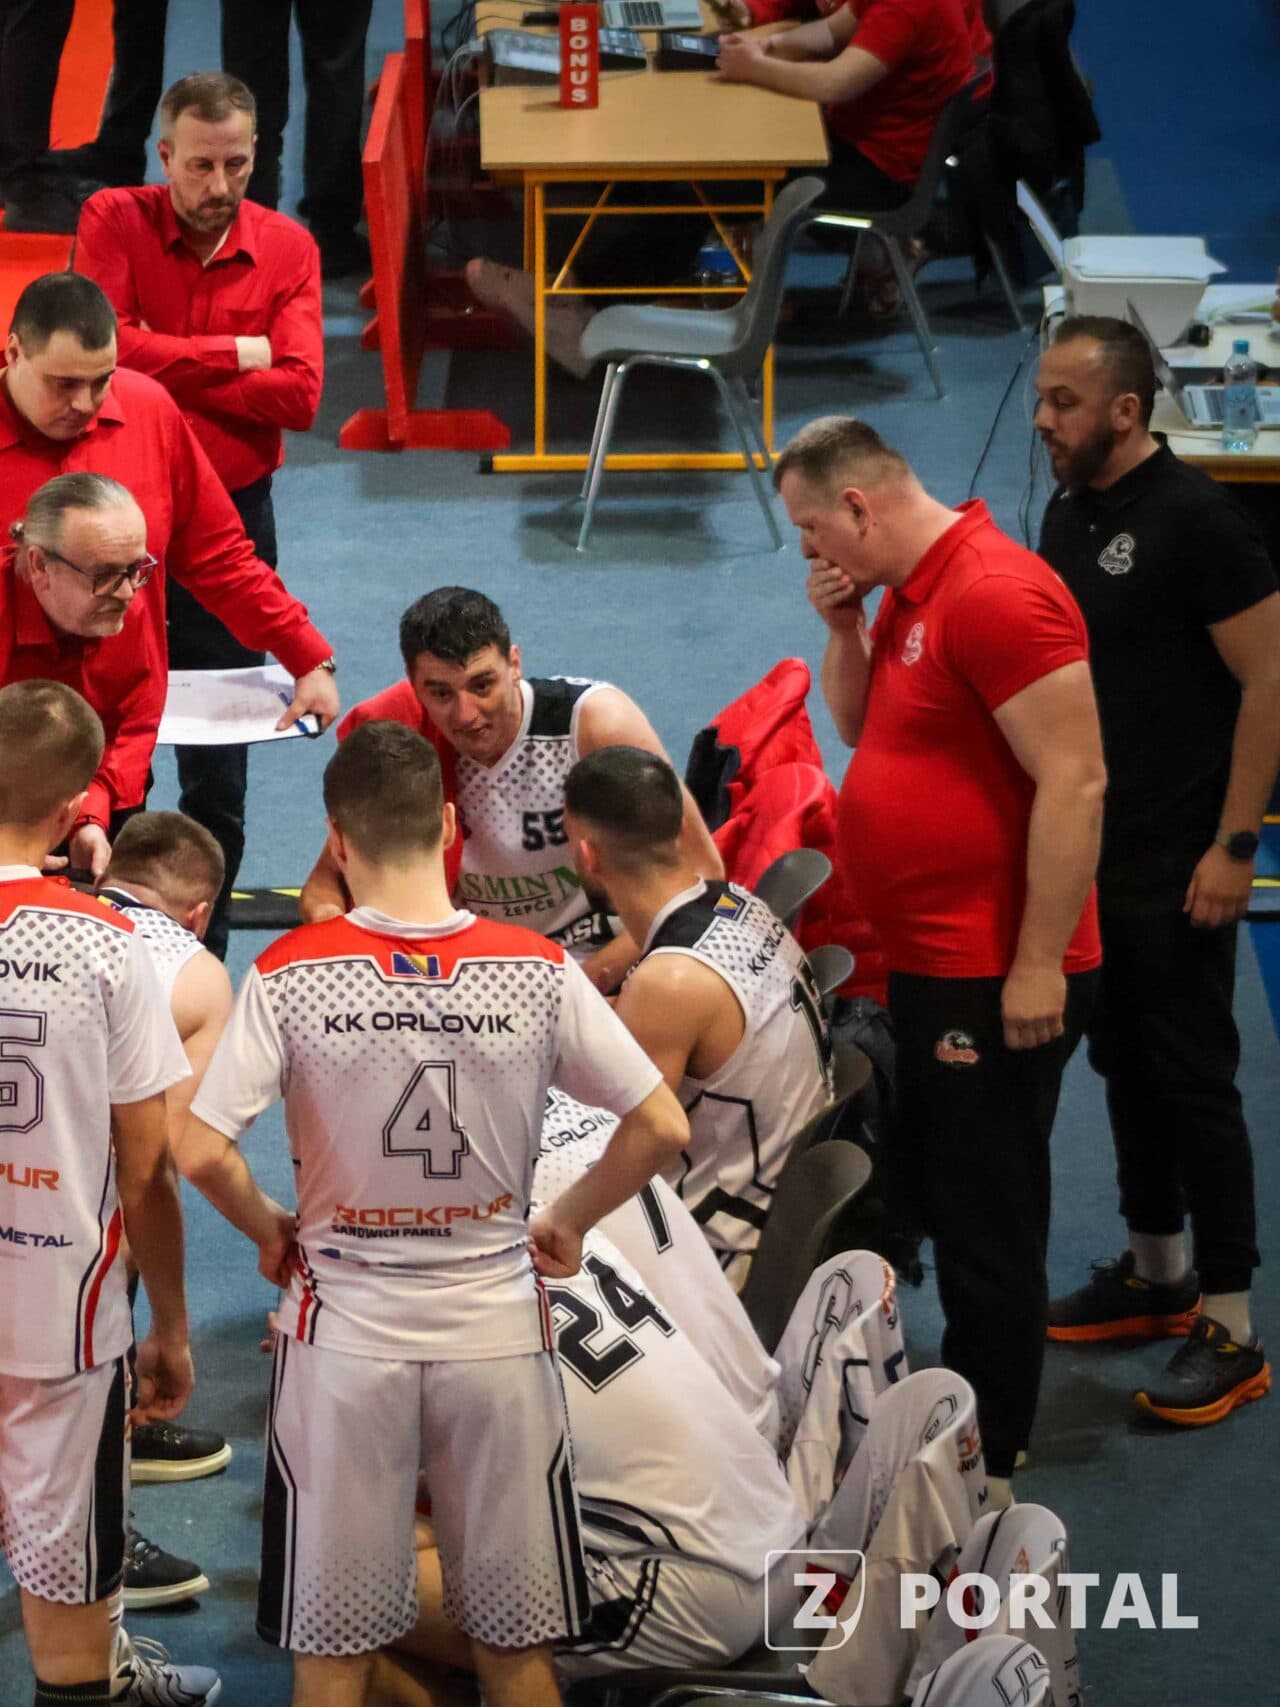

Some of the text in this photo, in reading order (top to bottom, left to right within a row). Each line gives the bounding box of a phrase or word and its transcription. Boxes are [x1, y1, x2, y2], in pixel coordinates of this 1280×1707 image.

[569, 18, 588, 103] BONUS
[521, 808, 569, 851] 55
[324, 1012, 515, 1034] KK ORLOVIK
[382, 1060, 469, 1179] 4
[331, 1192, 513, 1226] ROCKPUR
[331, 1225, 452, 1239] SANDWICH PANELS
[540, 1251, 676, 1394] 24
